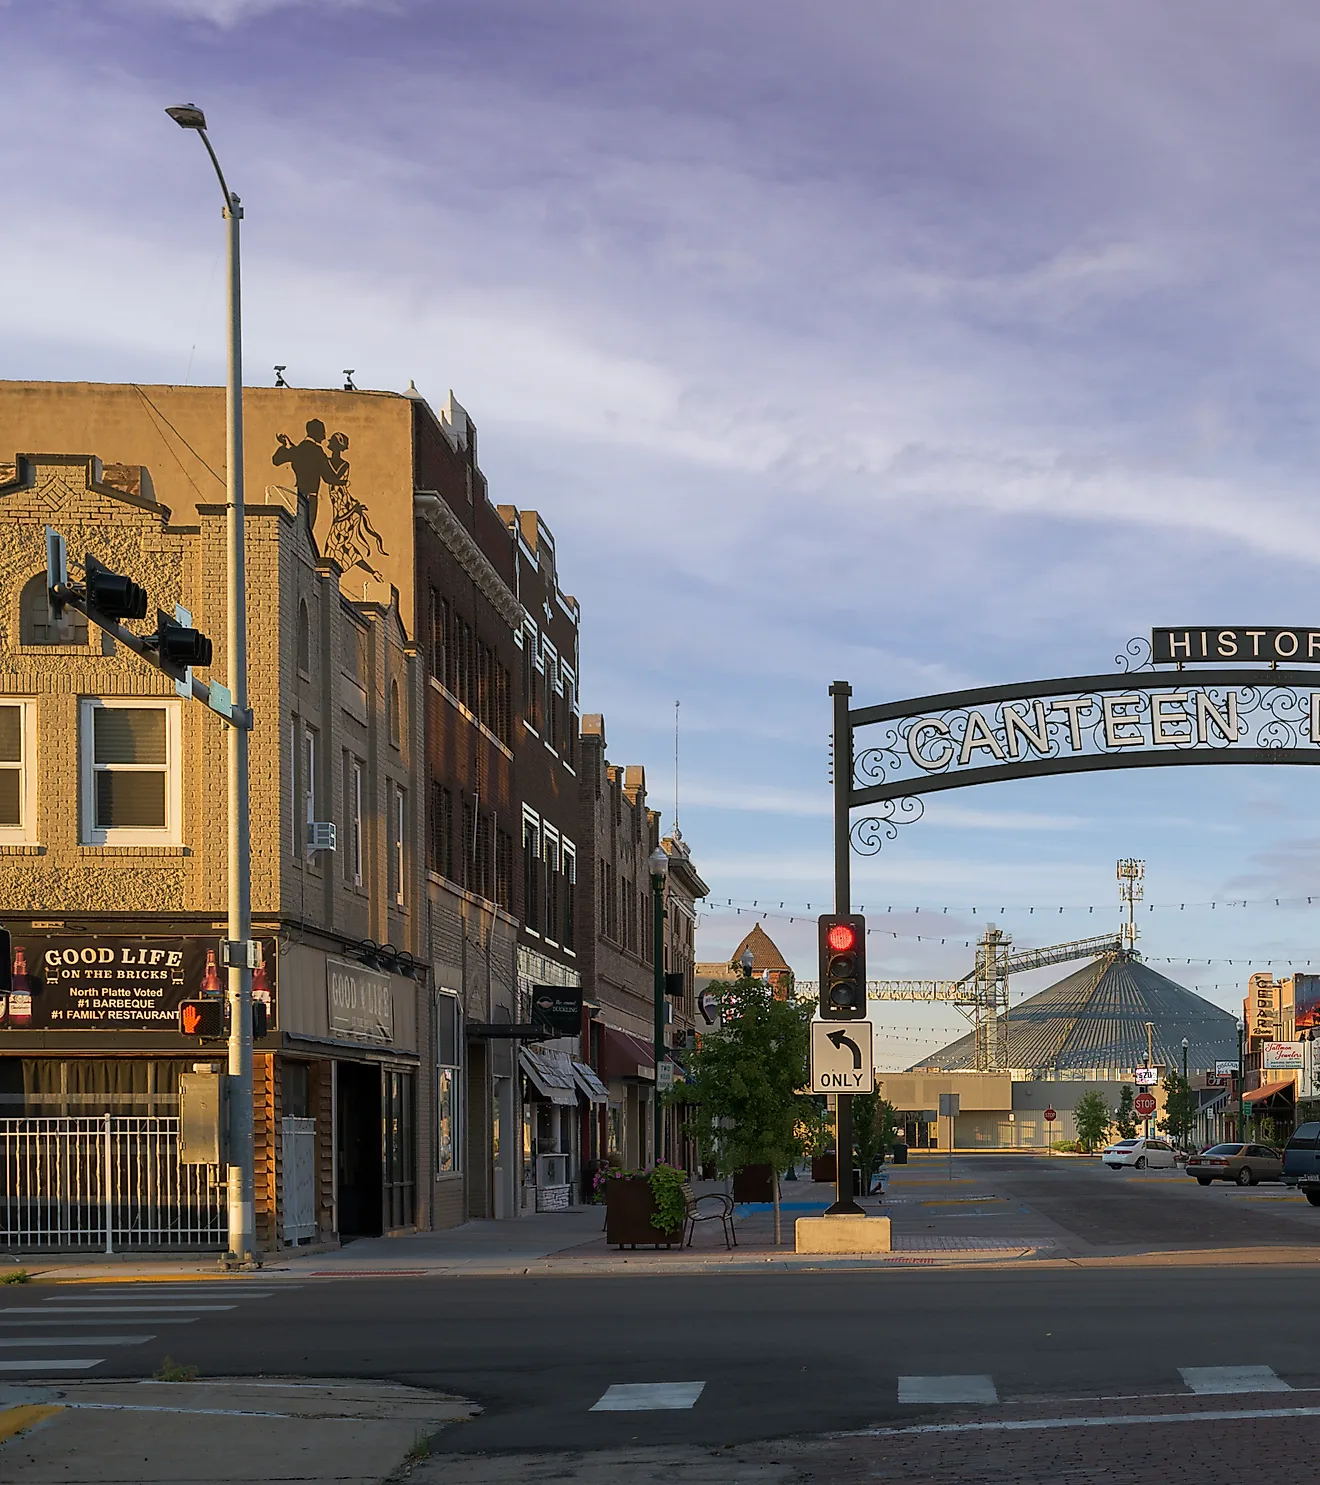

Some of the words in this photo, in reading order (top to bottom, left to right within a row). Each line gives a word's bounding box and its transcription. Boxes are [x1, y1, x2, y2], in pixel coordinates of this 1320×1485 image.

[907, 691, 1239, 770] CANTEEN
[45, 947, 115, 966] GOOD
[121, 948, 183, 967] LIFE
[61, 969, 80, 979] ON
[84, 970, 112, 979] THE
[116, 970, 168, 980] BRICKS
[69, 987, 98, 997] North
[101, 987, 131, 997] Platte
[133, 988, 163, 997] Voted
[332, 972, 357, 1009] GOOD
[77, 999, 90, 1008] #1
[93, 999, 155, 1009] BARBEQUE
[1256, 979, 1268, 1028] CEDAR
[51, 1010, 63, 1019] #1
[67, 1010, 105, 1020] FAMILY
[108, 1010, 180, 1020] RESTAURANT
[1274, 1050, 1302, 1060] Jewelers
[821, 1073, 864, 1087] ONLY
[1136, 1099, 1155, 1109] STOP
